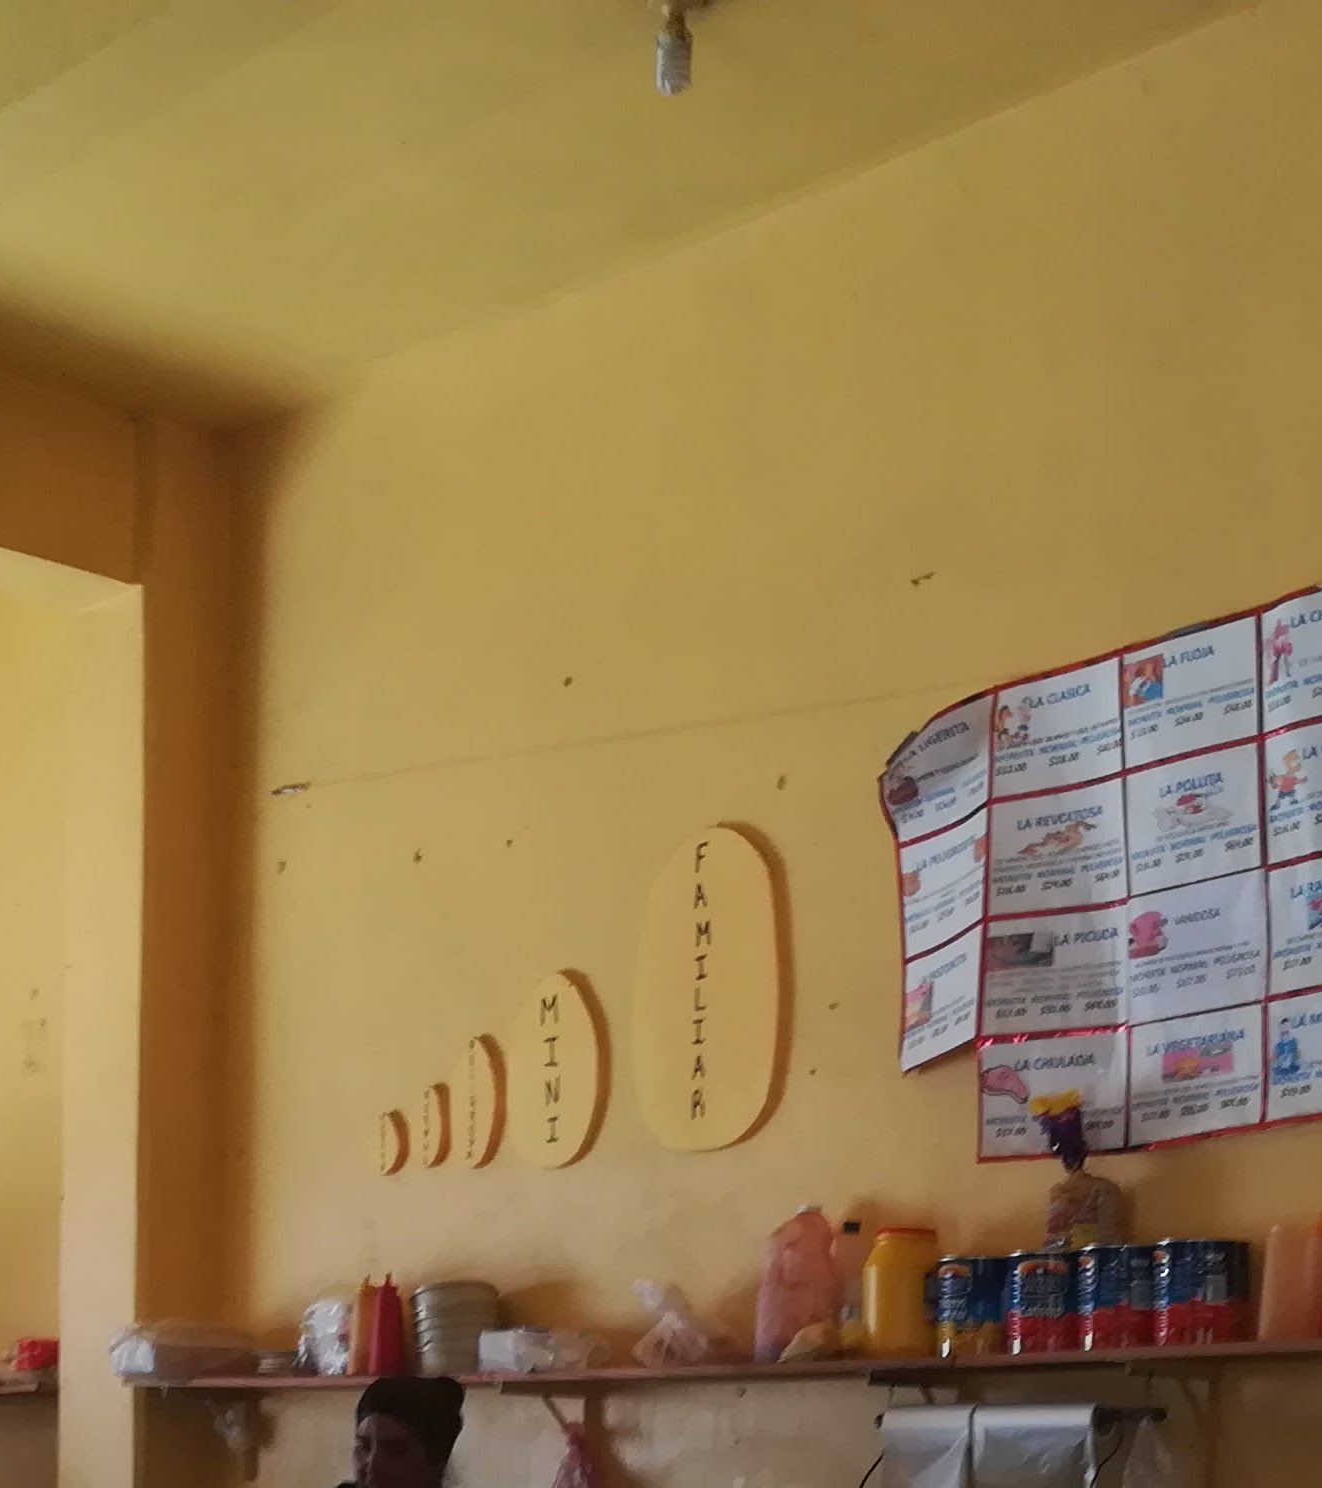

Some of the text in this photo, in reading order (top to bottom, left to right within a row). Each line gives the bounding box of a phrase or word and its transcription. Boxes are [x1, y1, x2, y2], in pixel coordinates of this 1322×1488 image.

[1290, 613, 1306, 629] LA
[1164, 655, 1178, 668] LA
[1029, 696, 1045, 709] LA
[1302, 746, 1318, 760] LA
[1159, 786, 1172, 798] LA
[1017, 819, 1032, 831] LA
[1290, 885, 1303, 899] LA
[691, 840, 713, 1120] FAMILIAR
[540, 993, 561, 1144] MINI
[1014, 1059, 1030, 1072] LA
